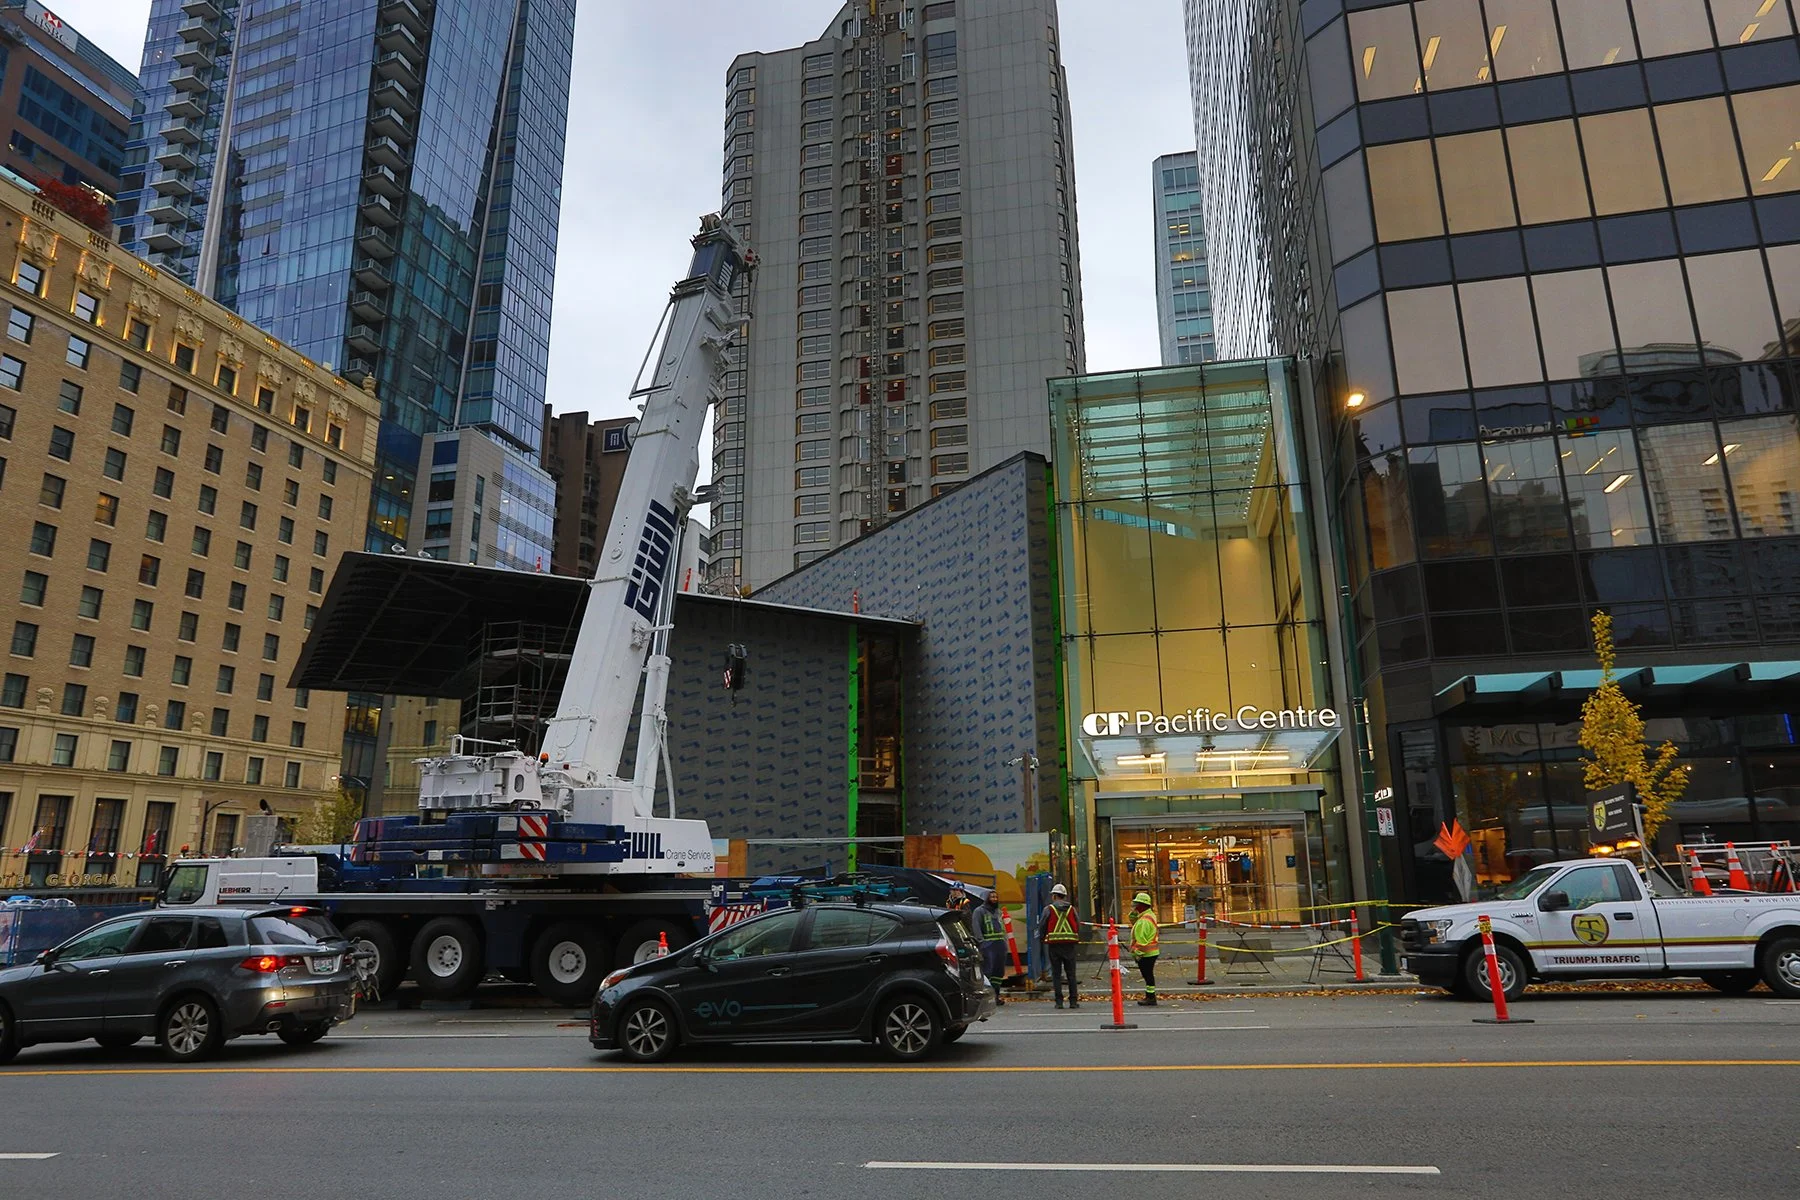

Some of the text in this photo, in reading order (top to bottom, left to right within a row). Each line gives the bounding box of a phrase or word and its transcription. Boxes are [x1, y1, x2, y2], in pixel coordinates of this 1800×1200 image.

[624, 499, 676, 623] GWIL
[1082, 705, 1337, 736] CF Pacific Centre
[666, 849, 687, 859] Crane
[687, 849, 711, 860] Service
[0, 873, 119, 887] TEL GEORGIA
[1554, 955, 1640, 964] TRIUMPH TRAFFIC
[697, 998, 742, 1018] evo
